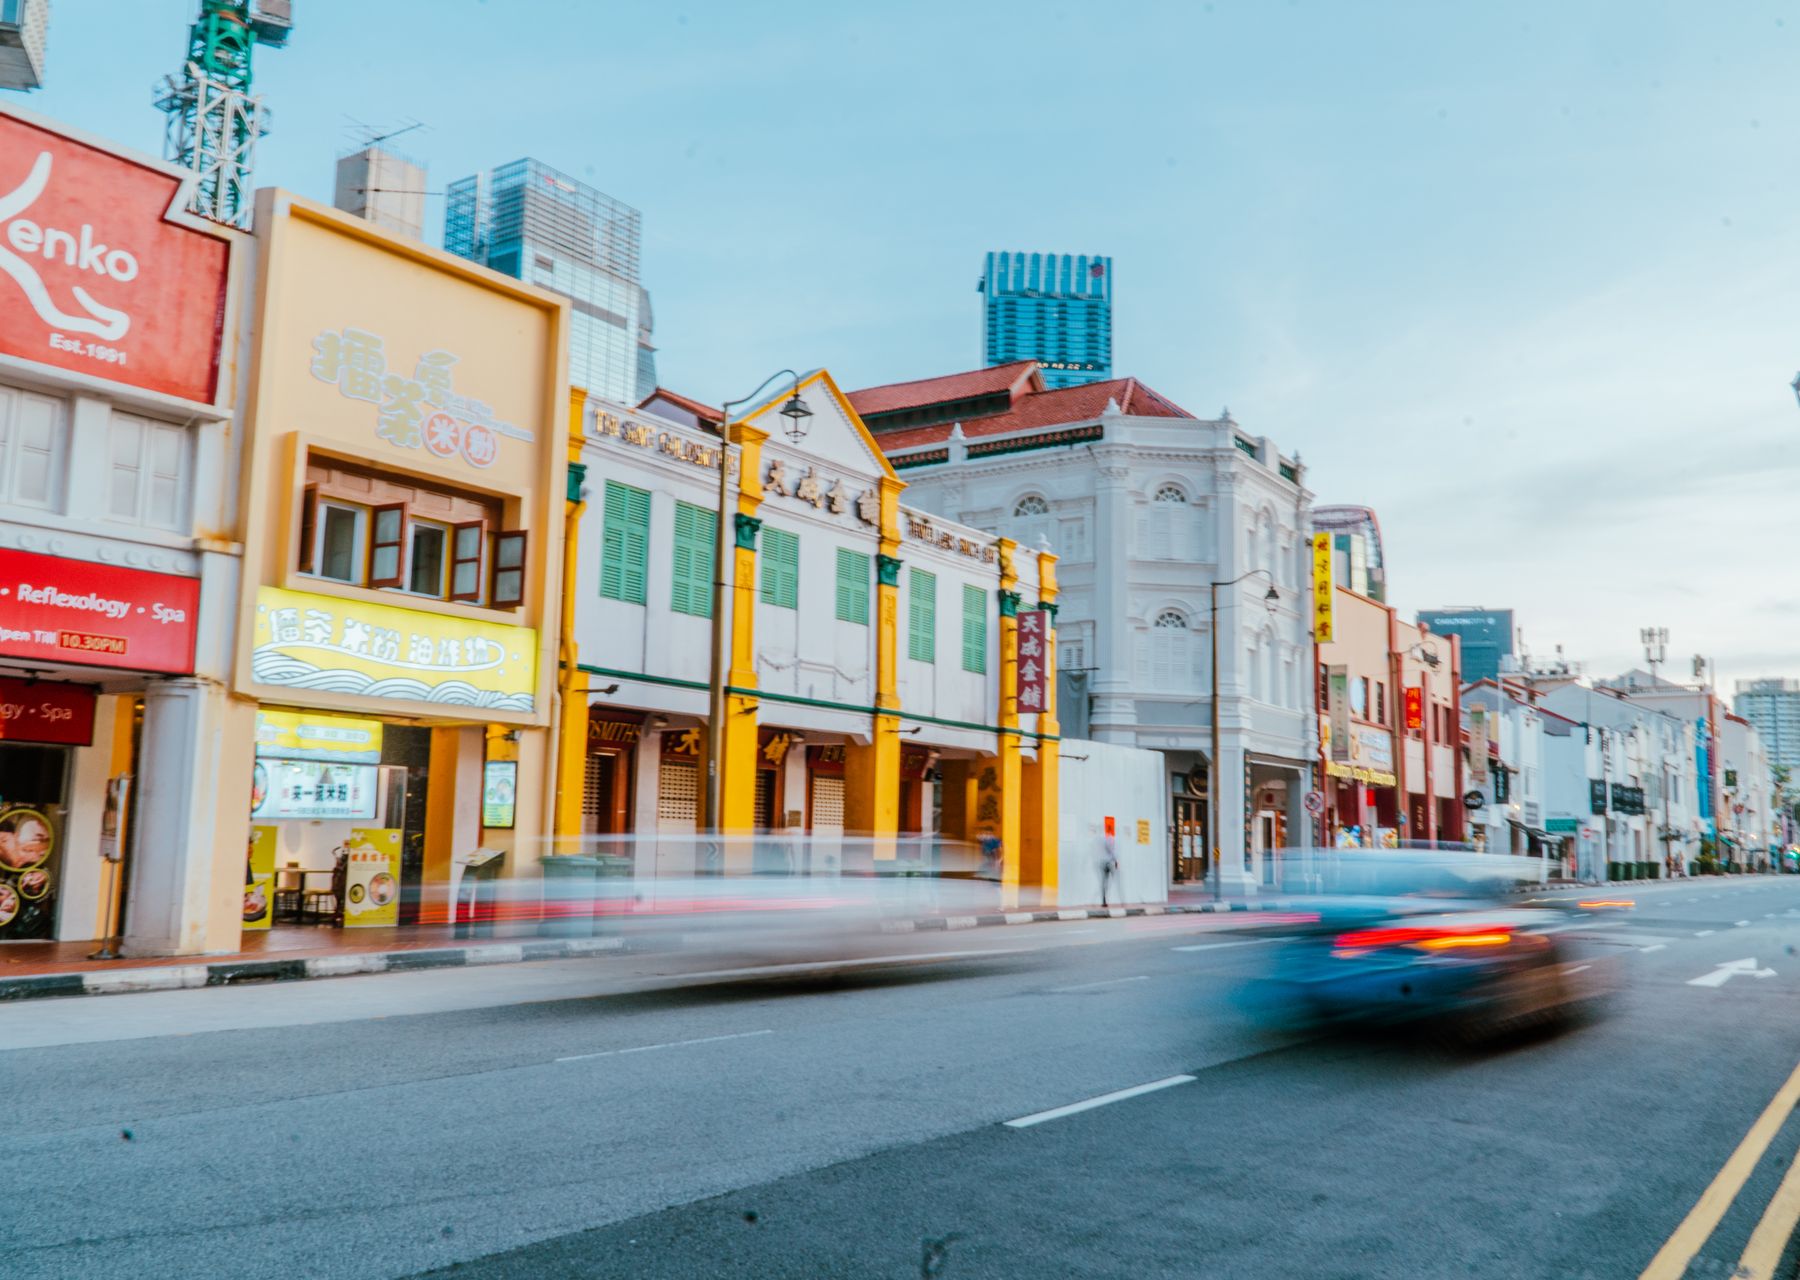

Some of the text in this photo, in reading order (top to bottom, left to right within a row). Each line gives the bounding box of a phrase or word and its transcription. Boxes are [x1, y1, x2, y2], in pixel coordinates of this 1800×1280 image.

[49, 332, 127, 365] Est.1991
[17, 584, 186, 624] Reflexology Spa
[61, 633, 126, 653] 10.30PM
[40, 703, 73, 723] Spa
